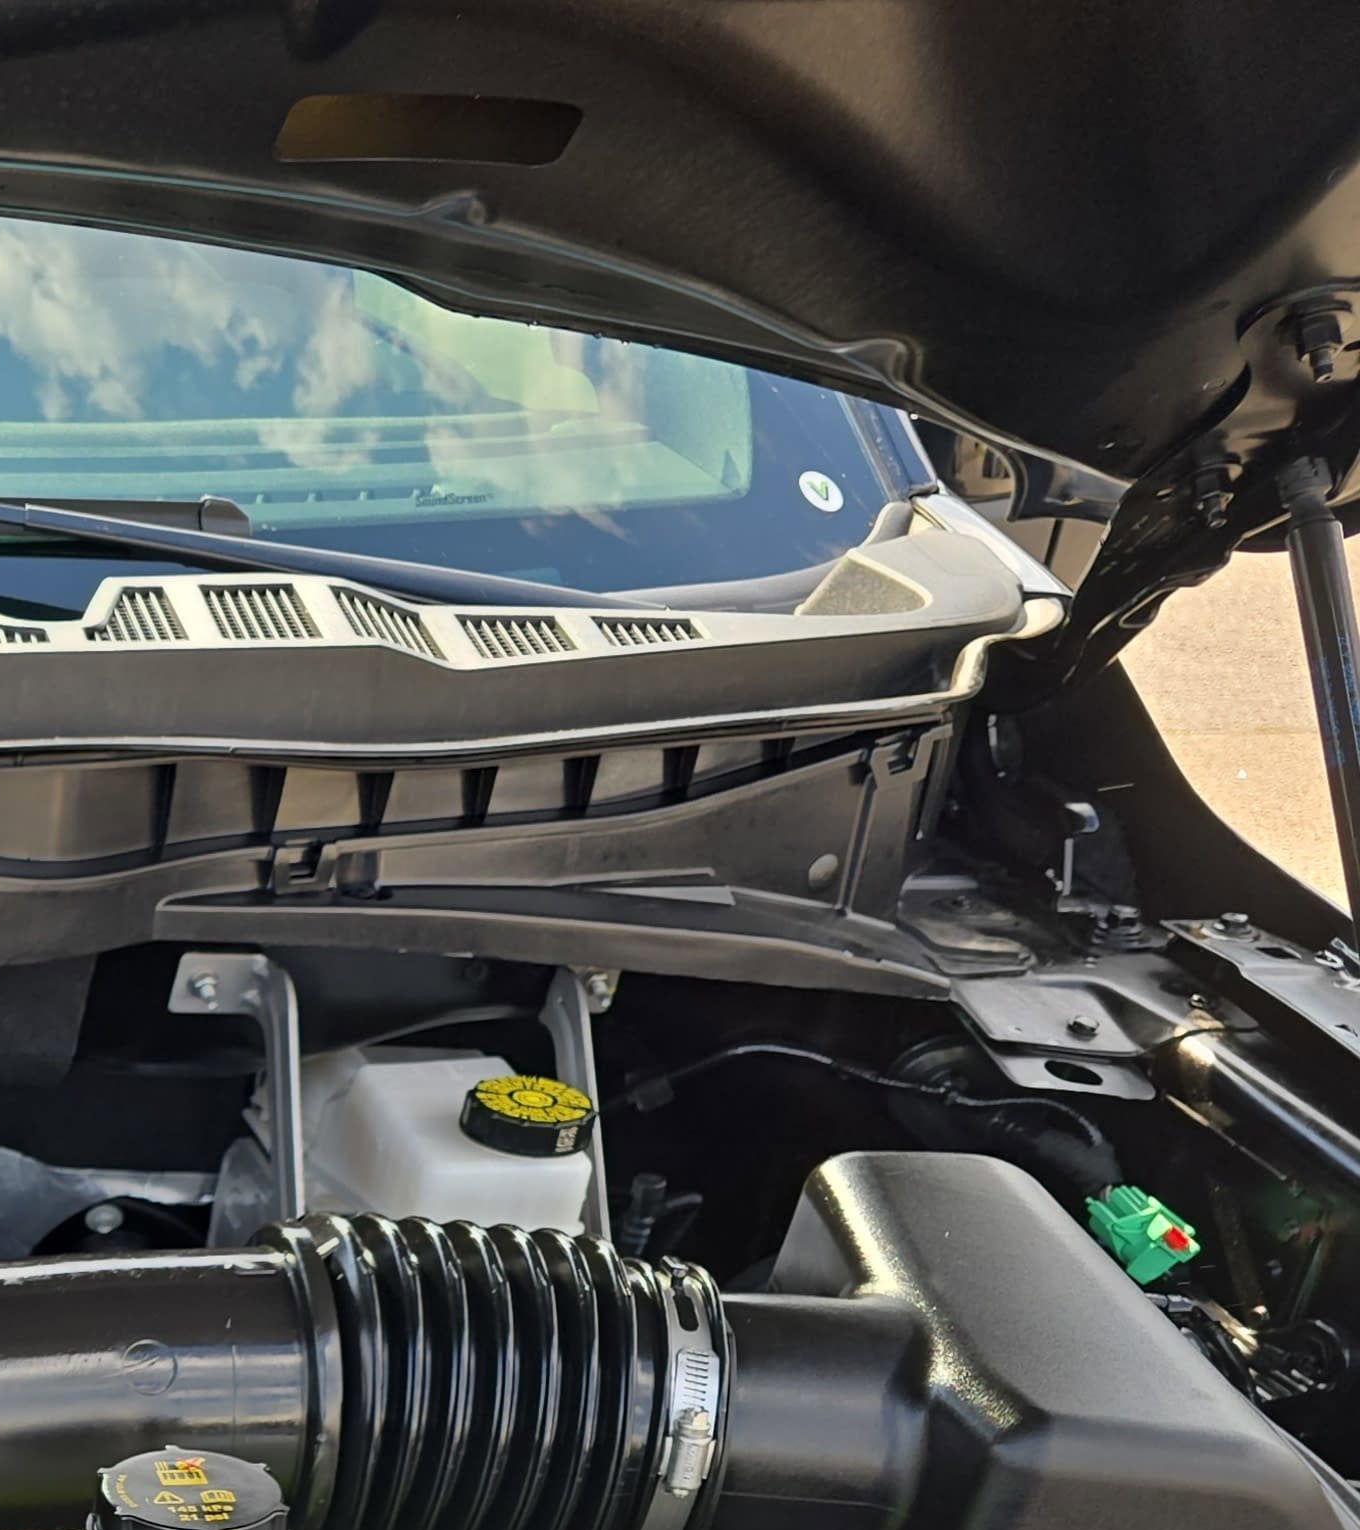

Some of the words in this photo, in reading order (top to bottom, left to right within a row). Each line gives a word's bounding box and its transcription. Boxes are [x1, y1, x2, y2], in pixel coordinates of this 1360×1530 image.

[201, 1504, 234, 1513] kPa
[179, 1513, 199, 1522] 21
[205, 1513, 230, 1522] psi
